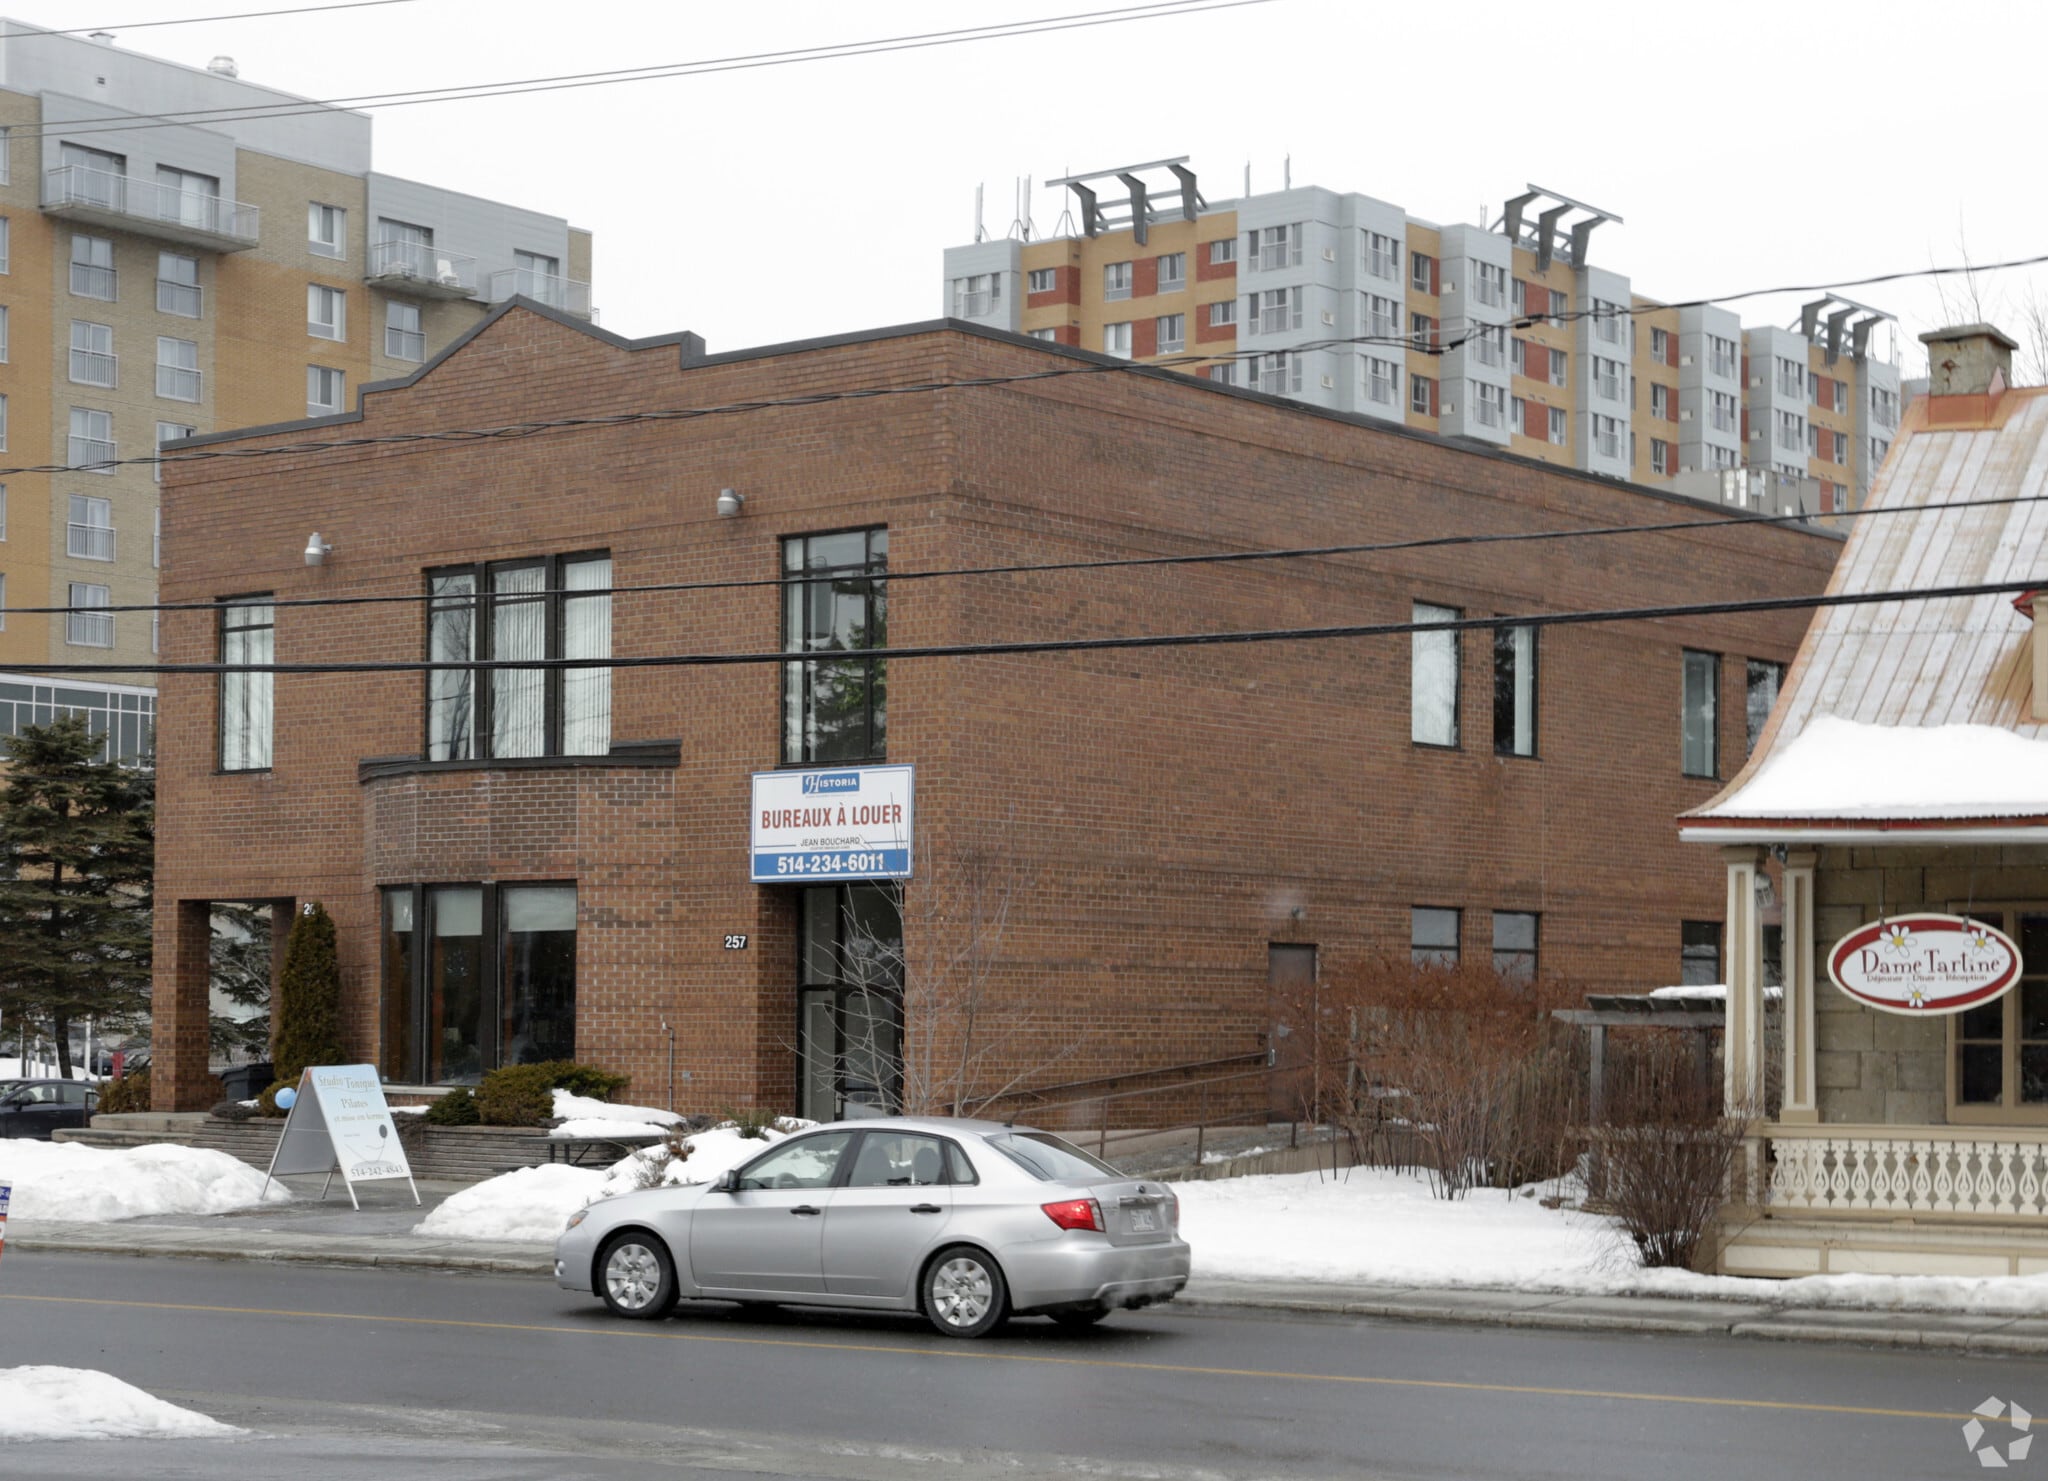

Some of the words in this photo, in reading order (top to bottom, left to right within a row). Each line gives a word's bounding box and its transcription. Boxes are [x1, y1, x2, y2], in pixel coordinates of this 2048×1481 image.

[762, 807, 832, 829] BUREAUX
[837, 802, 847, 826] À
[853, 804, 902, 825] LOUER
[800, 838, 819, 847] JEAN
[820, 836, 860, 846] BOUCHARD
[777, 853, 884, 874] 514-234-6011
[725, 935, 746, 949] 257
[1861, 949, 1921, 975] Dame
[1924, 949, 2000, 974] Tartine
[341, 1099, 368, 1108] Pilates
